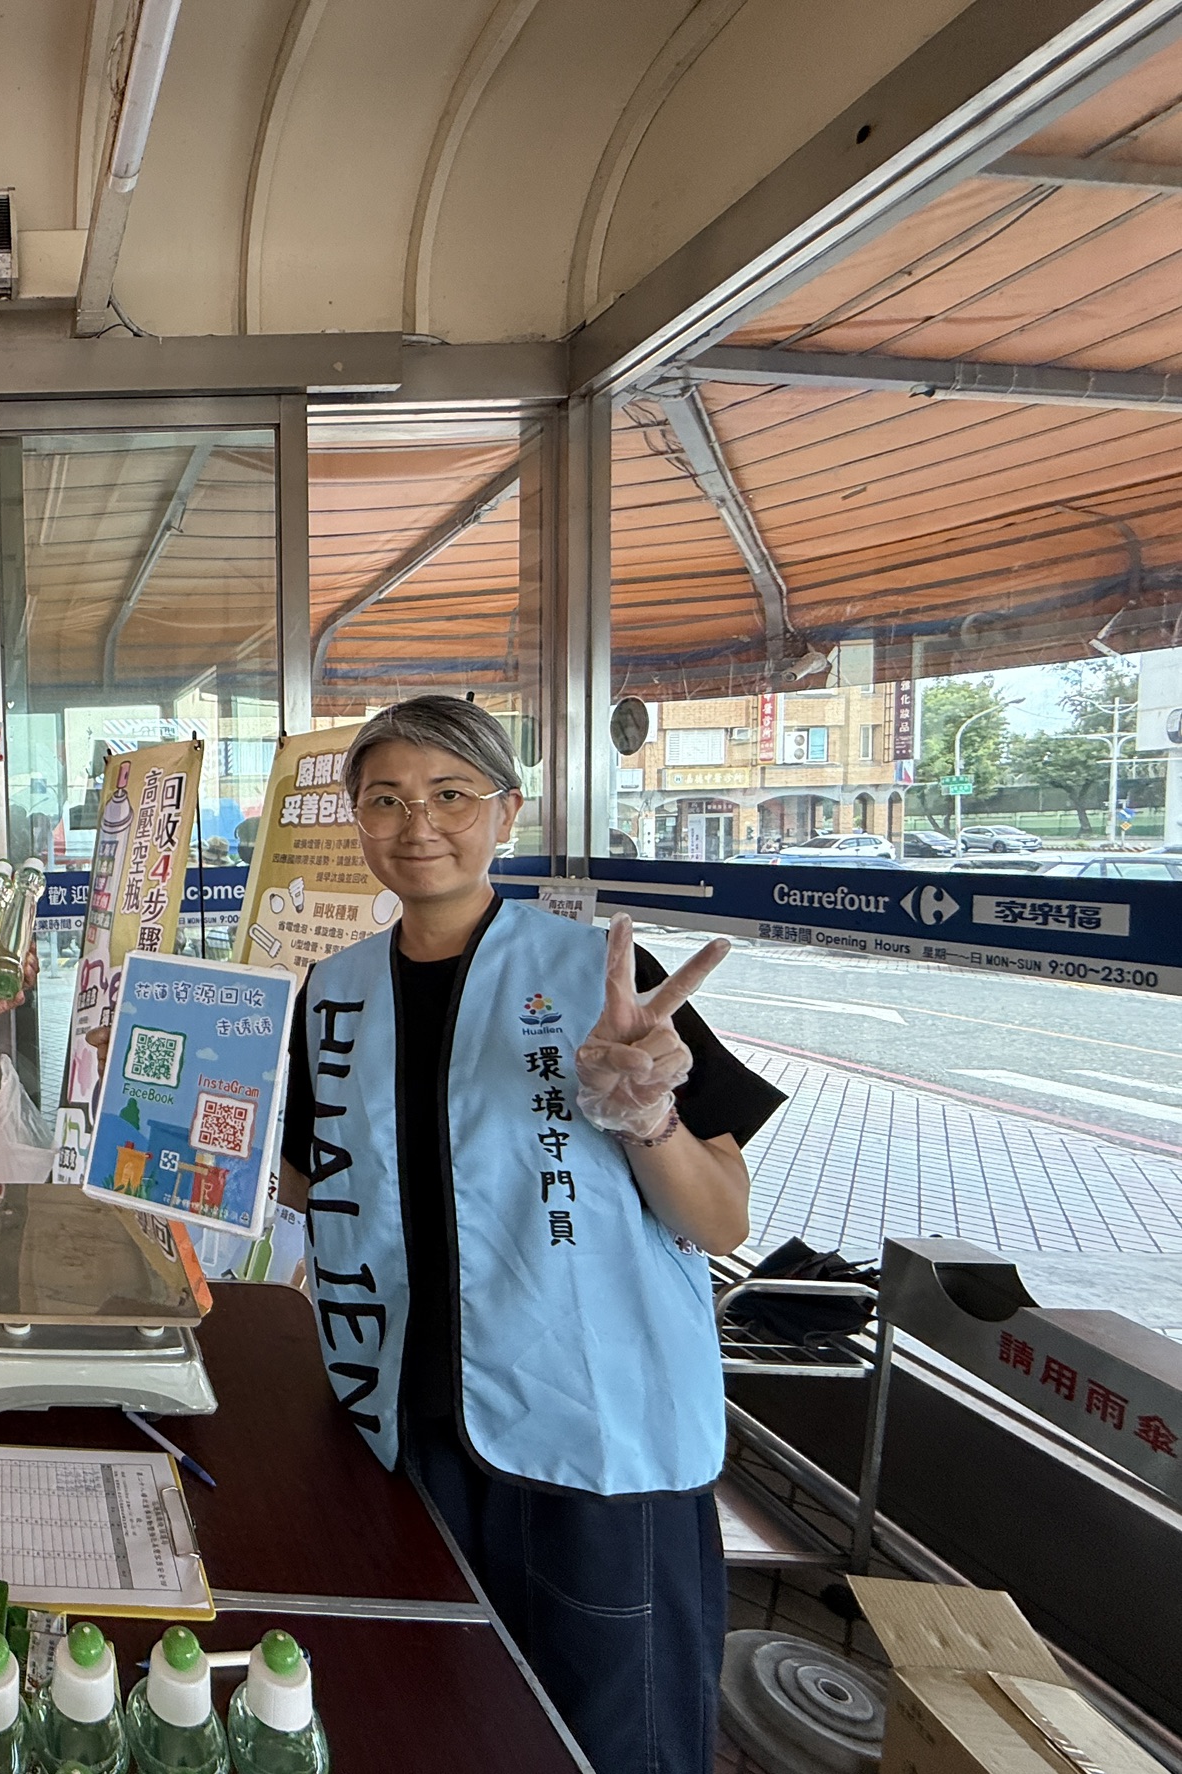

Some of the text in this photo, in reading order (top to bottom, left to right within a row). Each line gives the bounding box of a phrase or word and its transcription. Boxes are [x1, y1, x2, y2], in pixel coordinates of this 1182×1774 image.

[121, 767, 162, 912] 高壓空瓶
[48, 884, 89, 907] 歡迎
[773, 883, 890, 913] Carrefour
[312, 902, 359, 922] 回收種類
[994, 900, 1102, 930] 家樂福
[758, 923, 812, 944] 營業時間
[815, 931, 867, 950] Opening
[874, 939, 911, 954] Hours
[986, 954, 1042, 972] MON~SUN
[1048, 959, 1159, 987] 9:00~23:00
[134, 981, 266, 1008] 花蓮資源回收
[522, 1026, 564, 1036] Hualien
[122, 1082, 174, 1105] FaceBook
[198, 1073, 260, 1098] InstaGram
[523, 1045, 577, 1247] 環境守門員
[997, 1329, 1179, 1459] 請用雨傘
